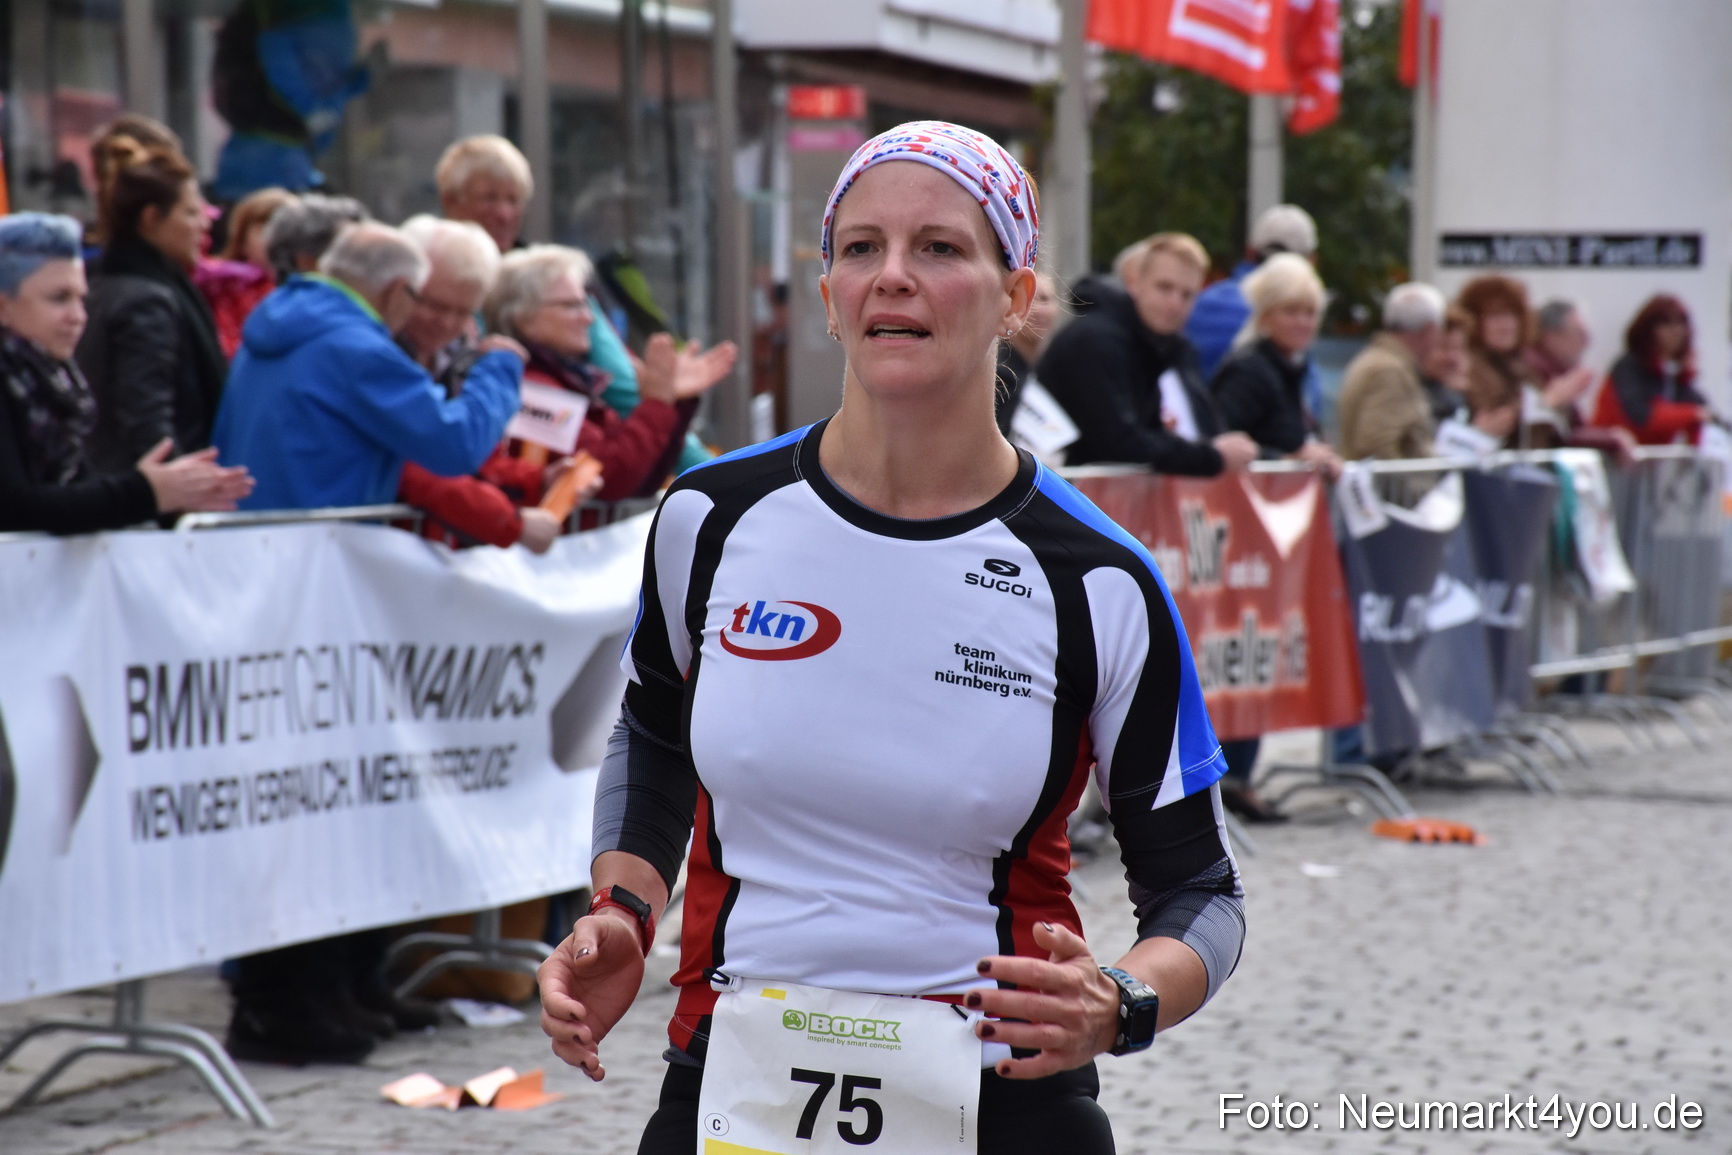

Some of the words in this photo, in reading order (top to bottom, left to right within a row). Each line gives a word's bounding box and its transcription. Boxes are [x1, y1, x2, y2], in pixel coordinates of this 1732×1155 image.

[731, 600, 806, 642] tkn
[954, 642, 996, 662] team
[934, 670, 1010, 698] nürnberg
[1013, 687, 1032, 698] e.V.
[964, 658, 1032, 684] klinikum
[808, 1012, 902, 1043] BOCK
[807, 1034, 835, 1044] inspired
[836, 1038, 846, 1046] by
[847, 1039, 868, 1048] smart
[869, 1042, 902, 1051] concepts
[790, 1067, 884, 1146] 75
[712, 1119, 722, 1131] C
